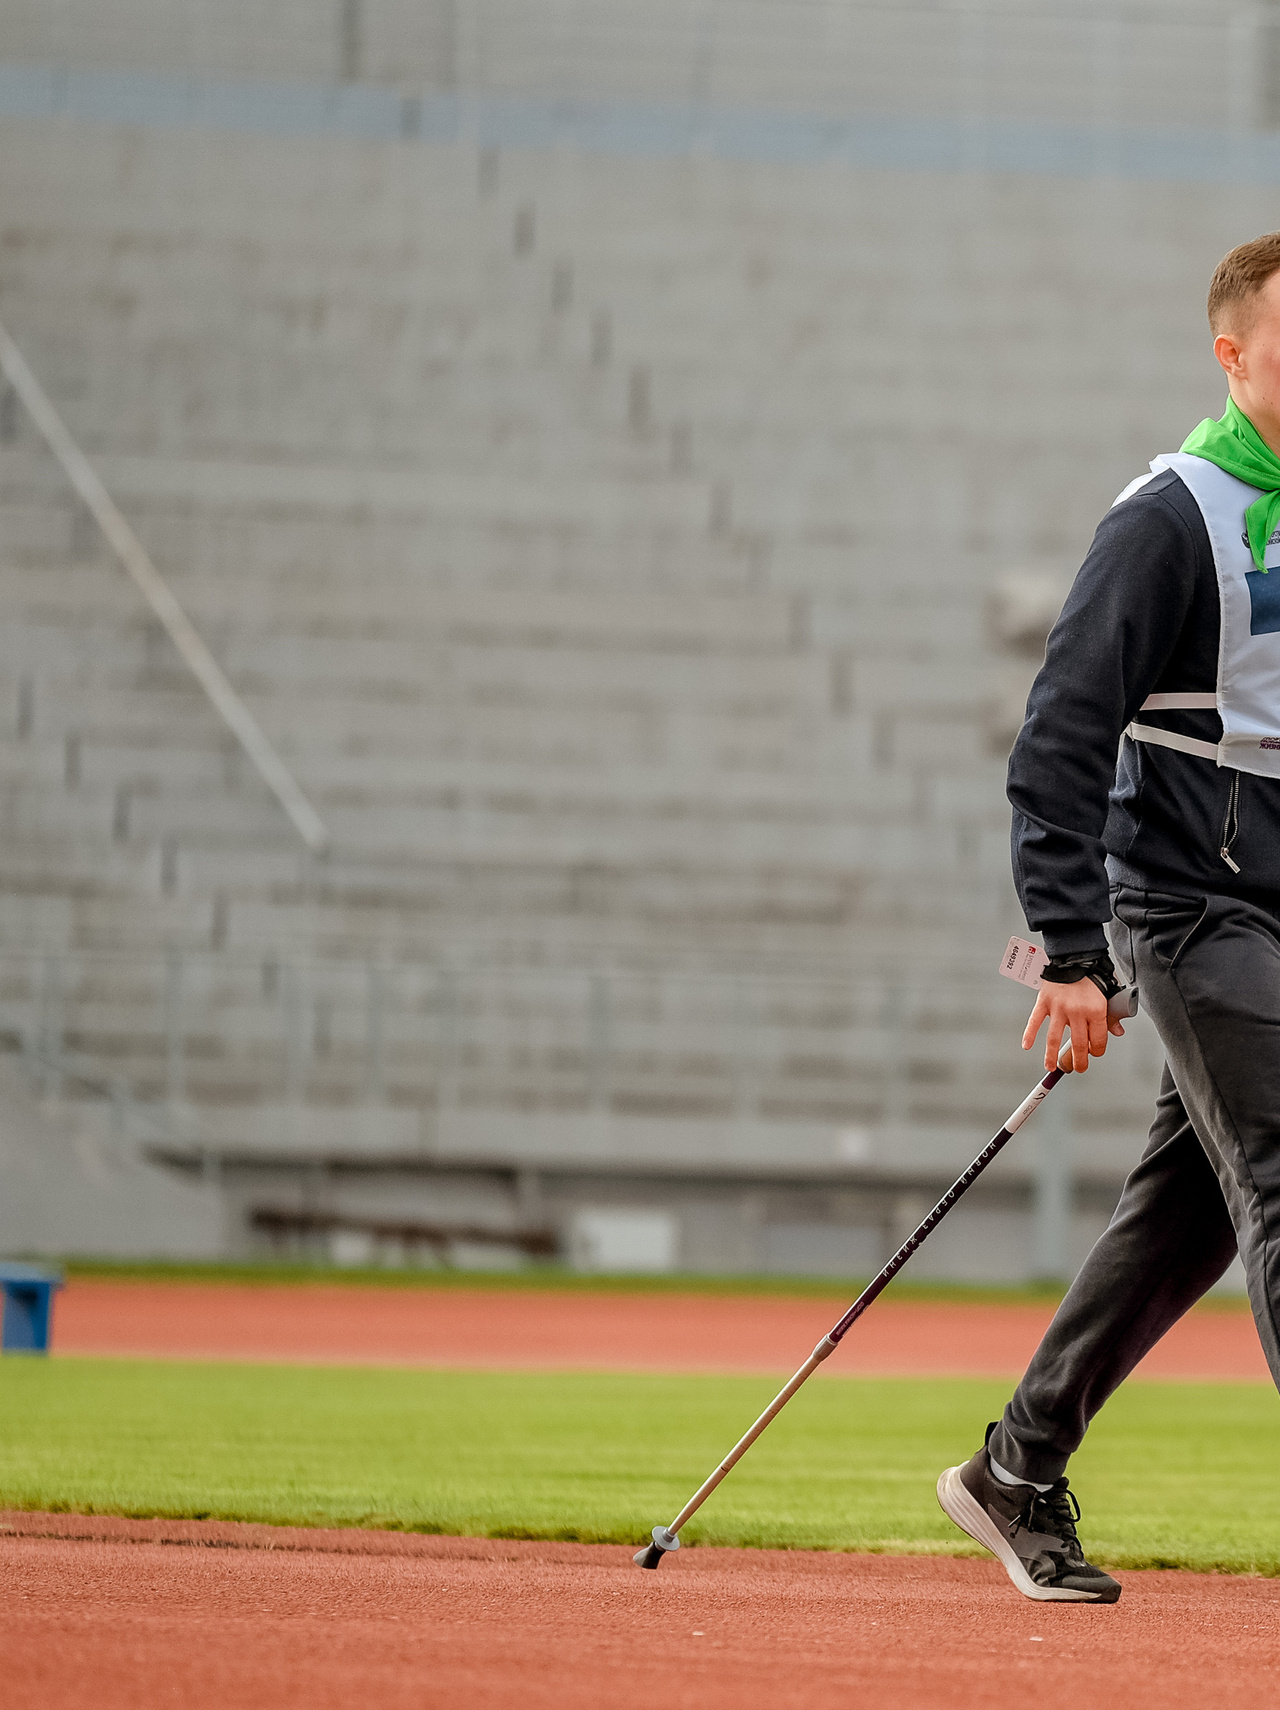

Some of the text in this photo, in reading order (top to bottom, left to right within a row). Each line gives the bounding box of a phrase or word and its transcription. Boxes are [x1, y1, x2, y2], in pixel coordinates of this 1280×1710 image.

[881, 1141, 996, 1277] НОВЫЙ ОБРАЗ ЖИЗНИ
